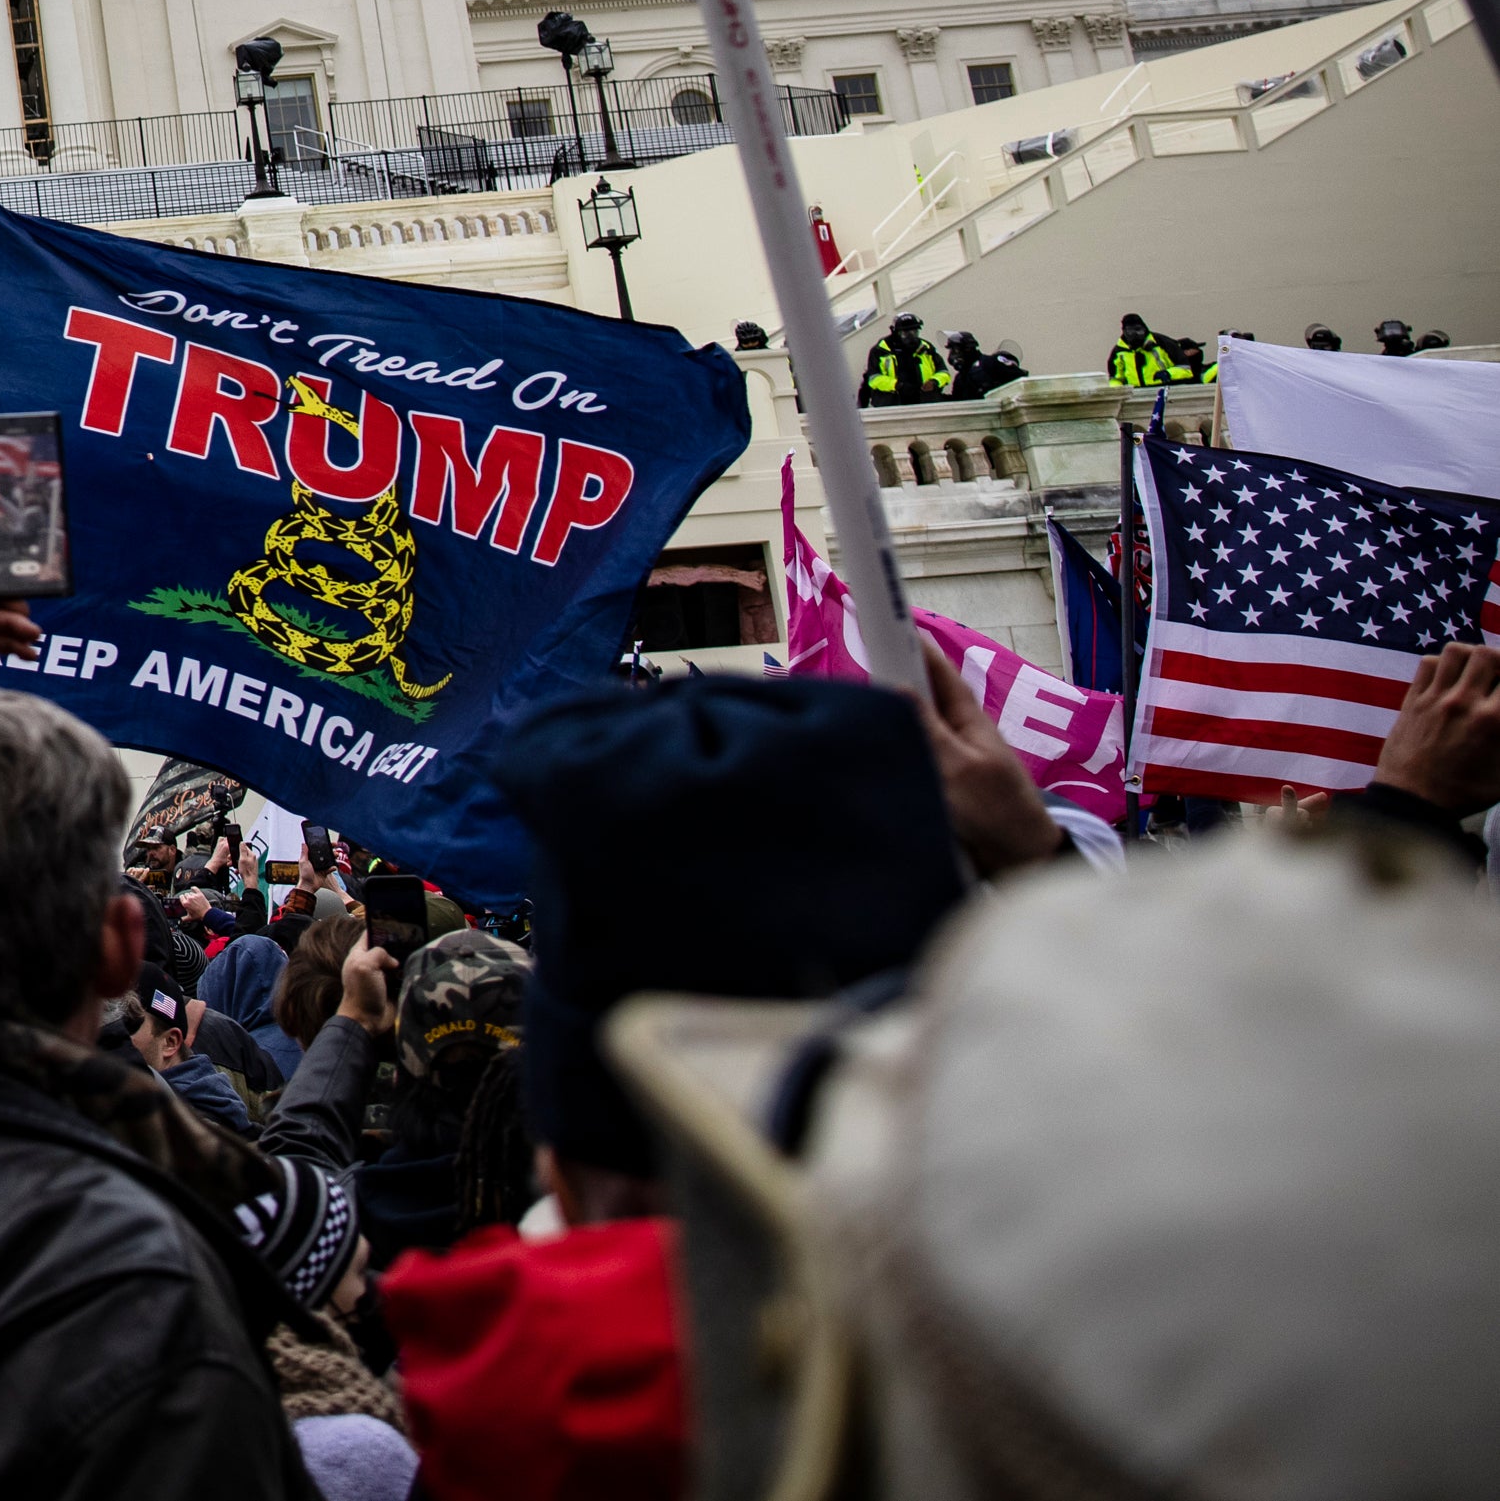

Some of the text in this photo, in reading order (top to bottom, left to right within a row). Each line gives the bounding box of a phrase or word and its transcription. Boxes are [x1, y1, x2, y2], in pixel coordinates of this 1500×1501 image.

[118, 289, 609, 414] Don't Tread On
[63, 305, 636, 567] TRUMP
[130, 651, 375, 771] AMERICA
[424, 1018, 477, 1045] DONALD
